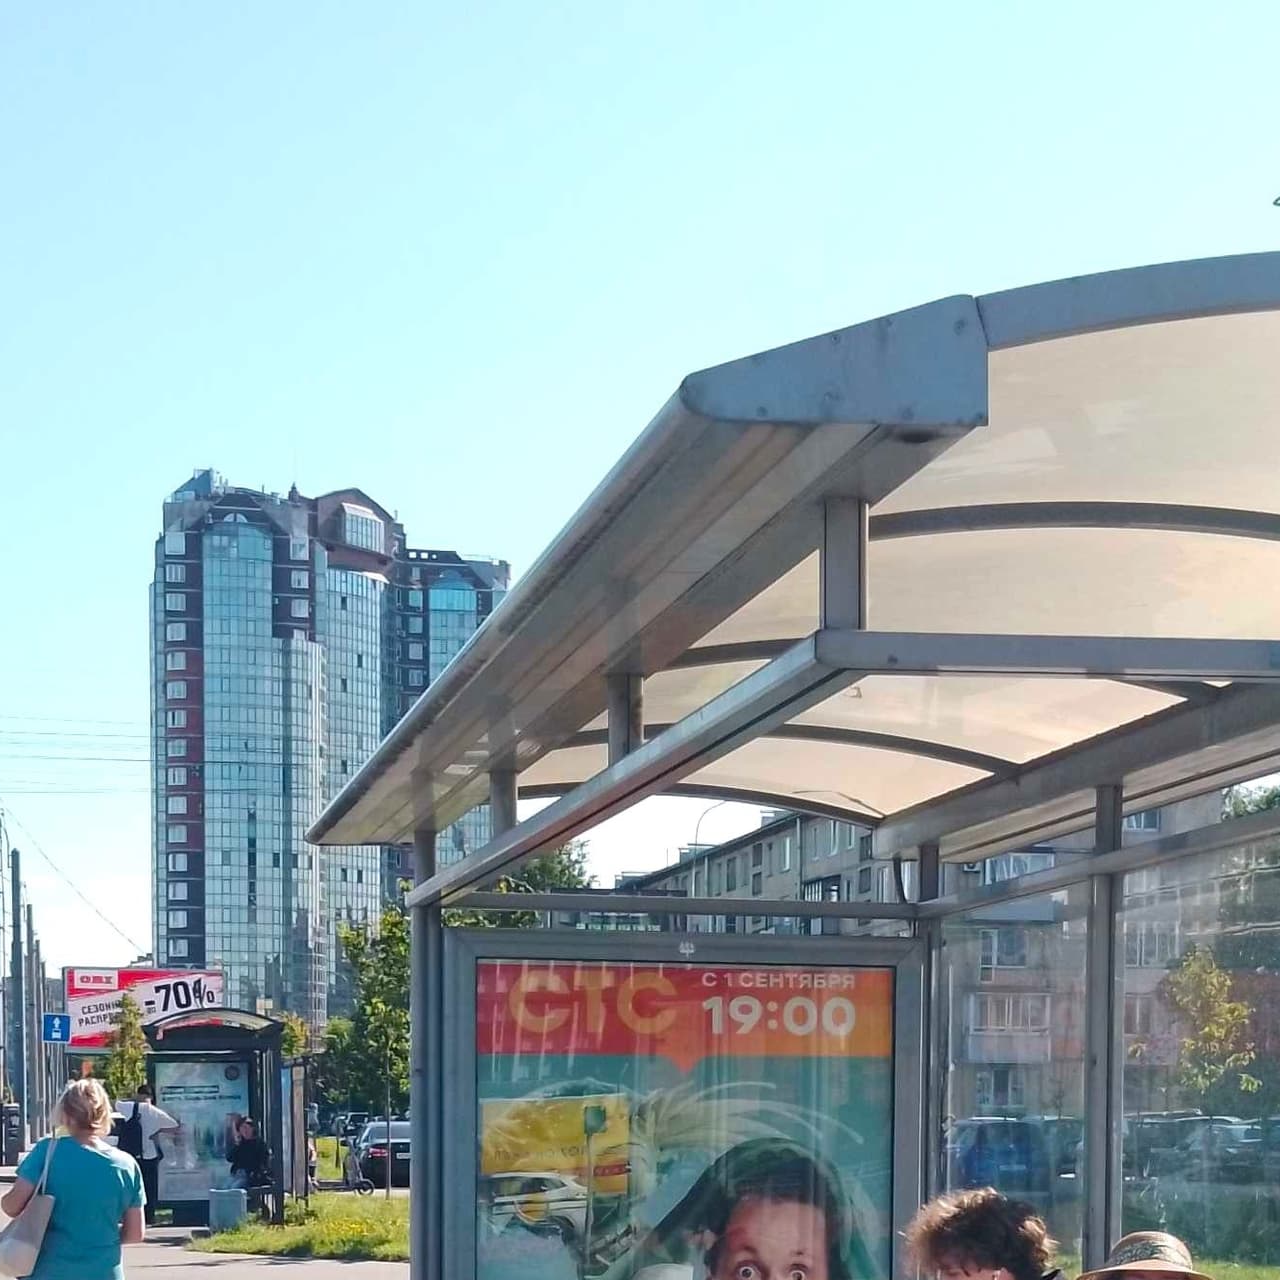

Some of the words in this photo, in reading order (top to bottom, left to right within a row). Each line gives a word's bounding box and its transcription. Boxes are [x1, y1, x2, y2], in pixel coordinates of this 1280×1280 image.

[723, 972, 731, 988] 1
[740, 972, 856, 990] СЕНТЯБРЯ
[508, 970, 679, 1035] СТС
[702, 995, 857, 1036] 19:00
